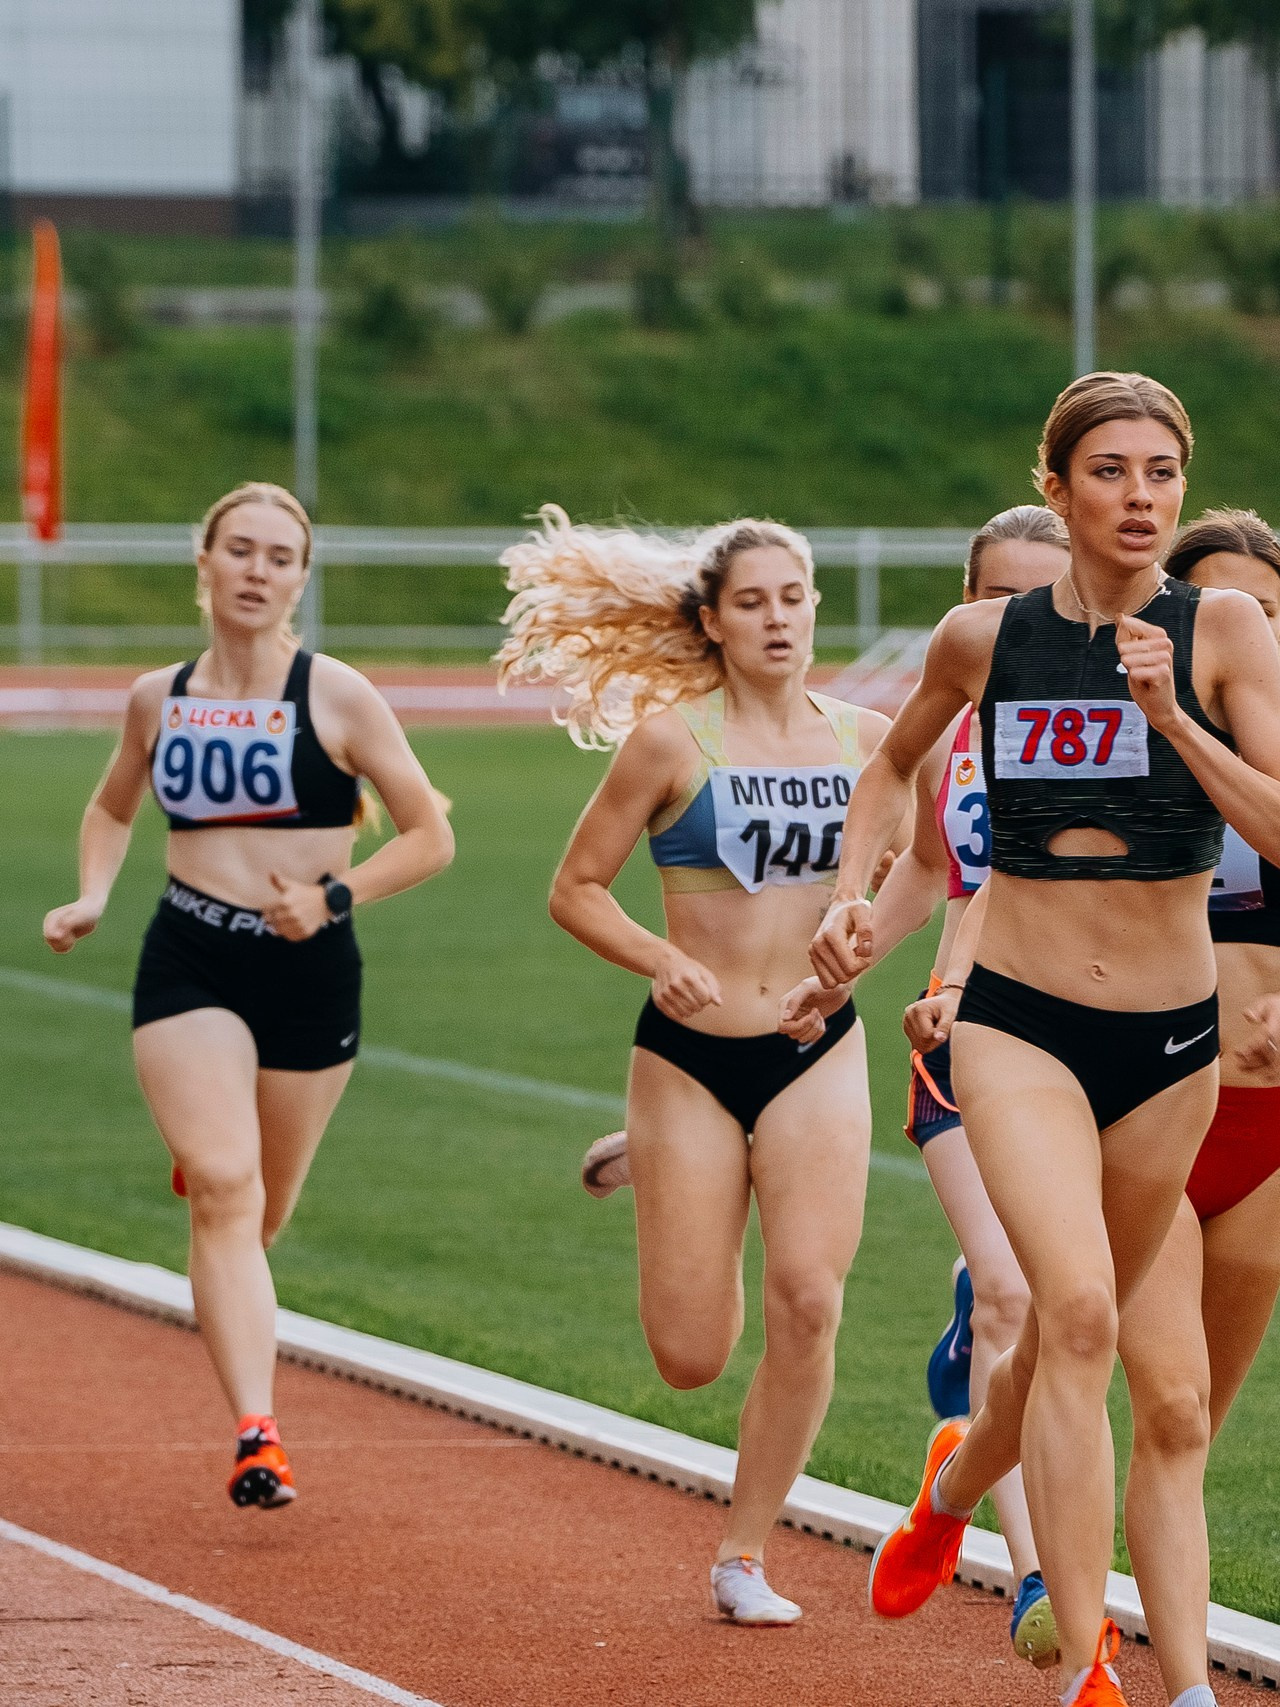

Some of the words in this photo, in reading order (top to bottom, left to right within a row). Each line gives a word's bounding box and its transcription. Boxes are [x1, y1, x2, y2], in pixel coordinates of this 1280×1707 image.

[188, 707, 257, 728] ЦСКА
[1017, 707, 1122, 767] 787
[163, 737, 282, 806] 906
[730, 774, 851, 809] МГФСО
